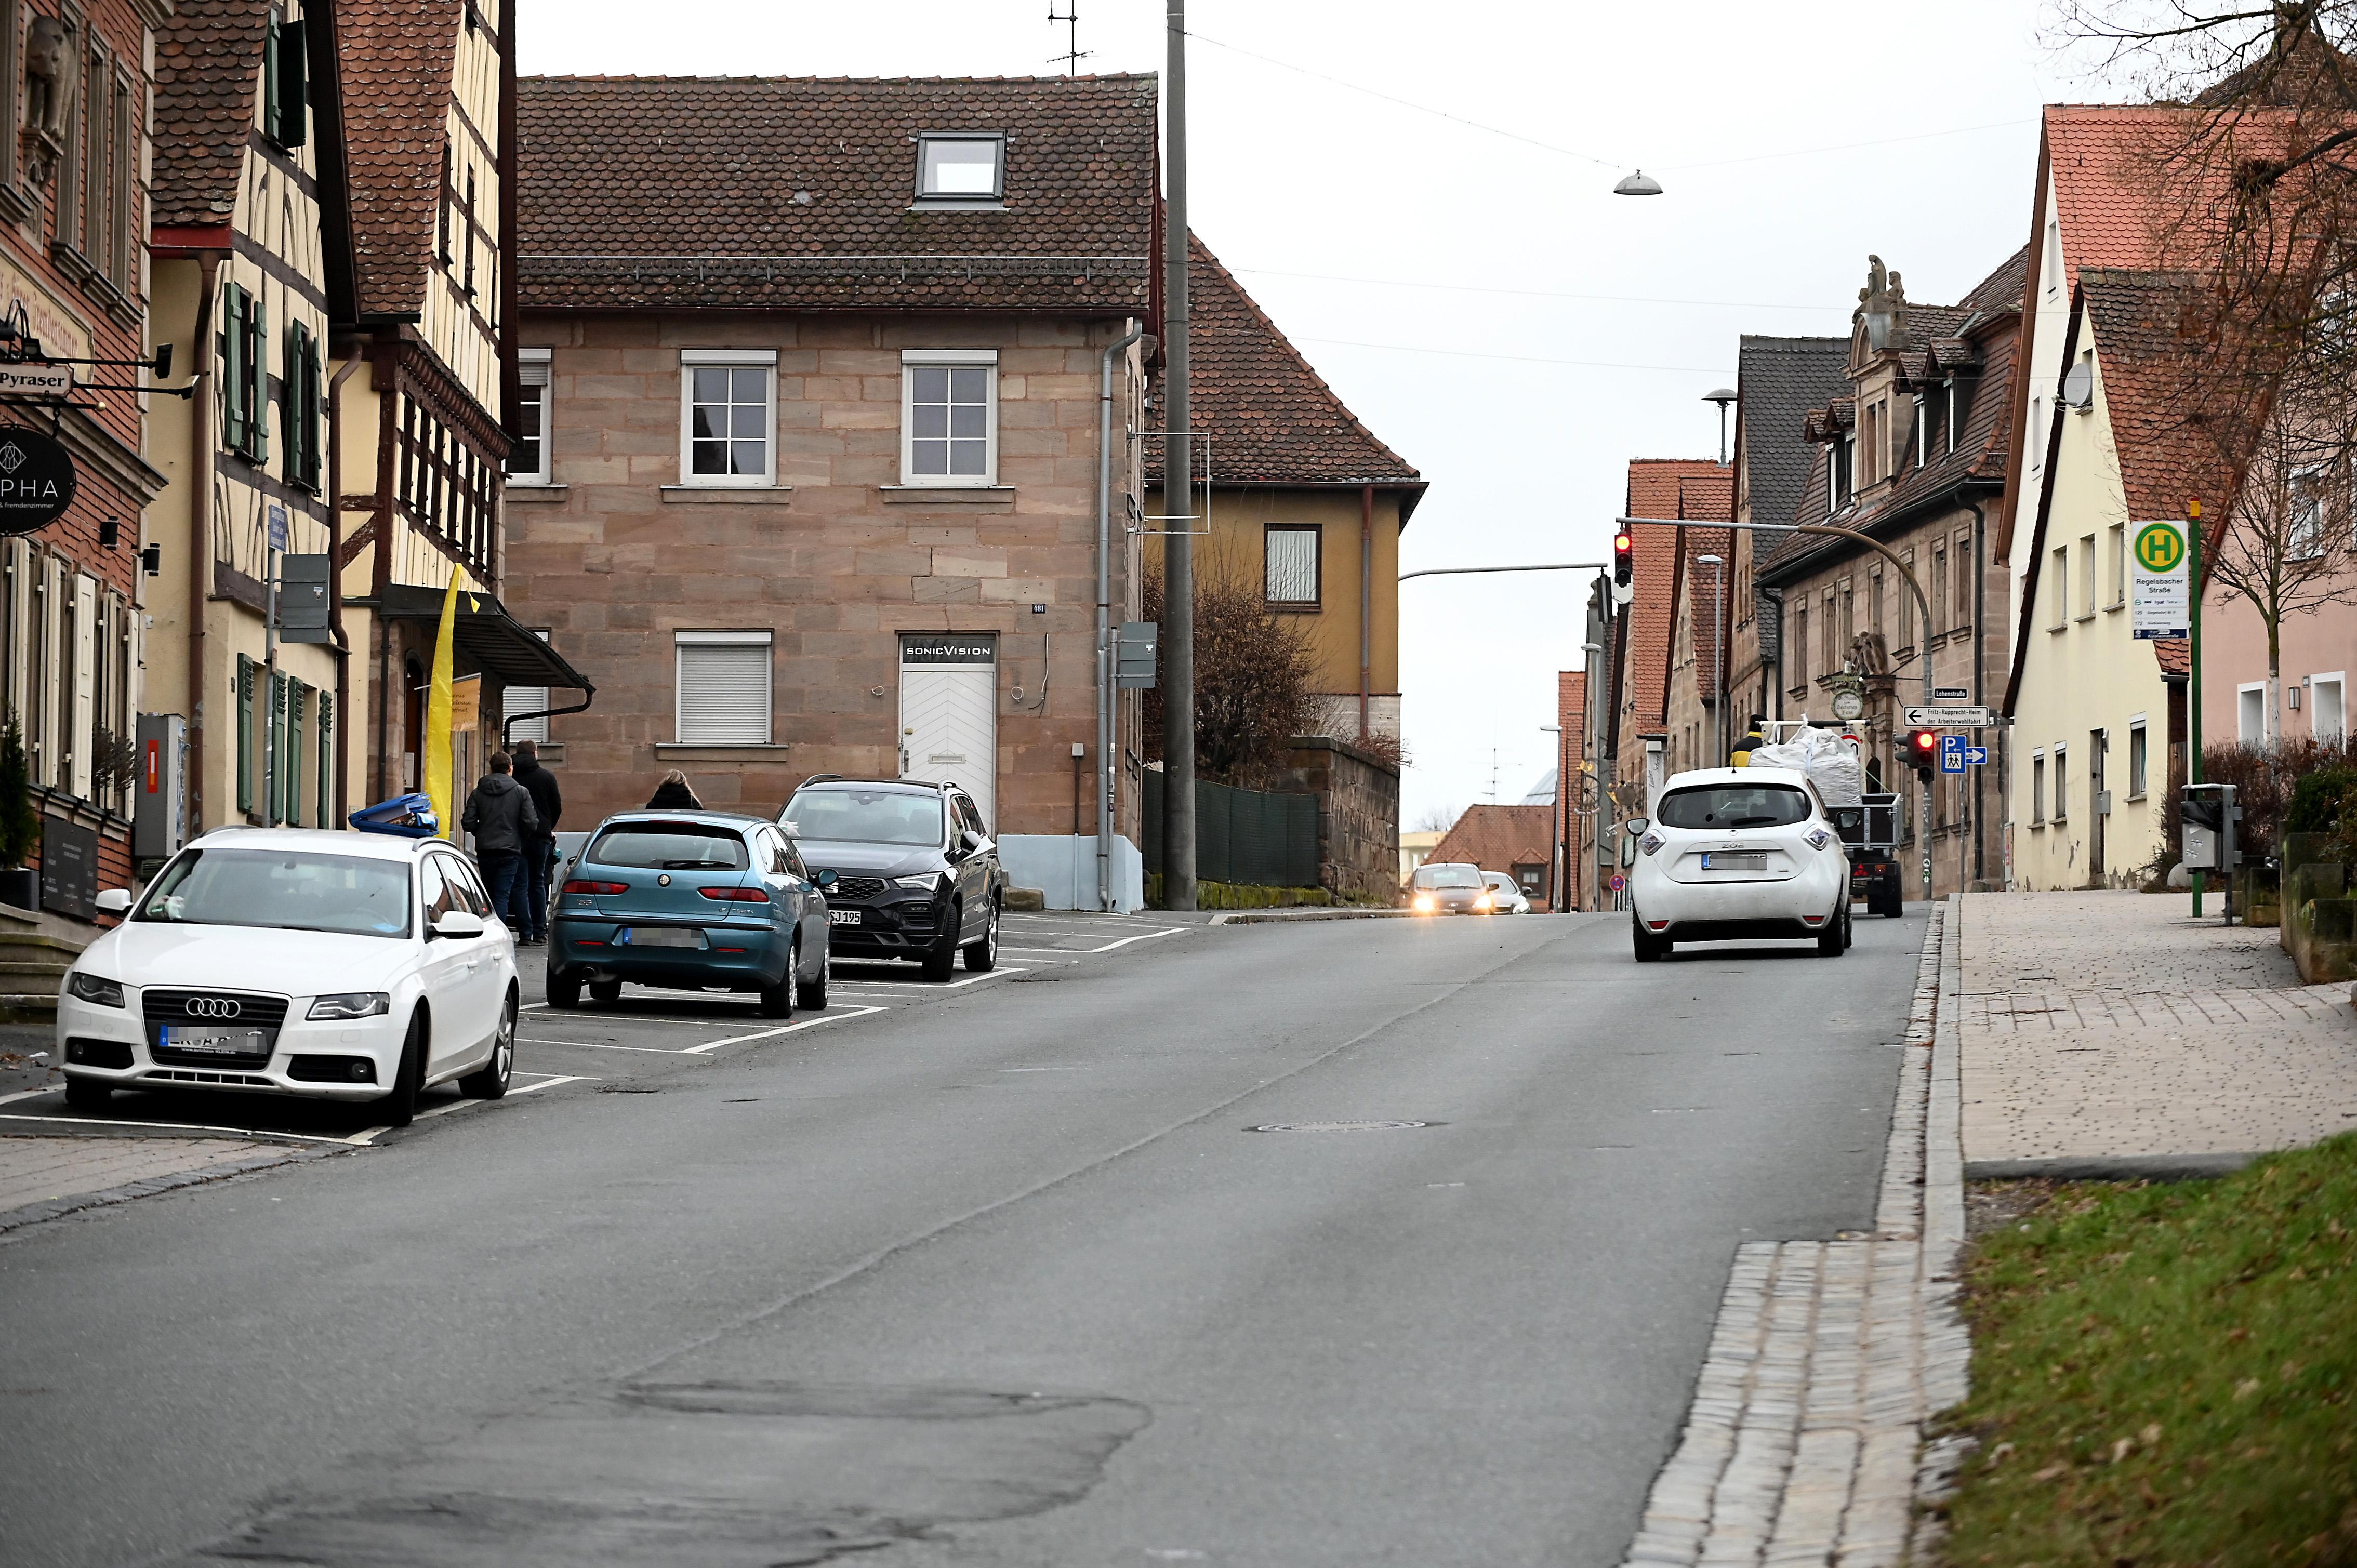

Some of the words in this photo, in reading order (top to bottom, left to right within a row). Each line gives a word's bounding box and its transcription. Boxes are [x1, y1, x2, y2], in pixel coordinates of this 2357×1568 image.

[0, 371, 65, 388] Pyraser
[2149, 535, 2171, 561] H
[1945, 737, 1956, 752] P
[843, 912, 860, 923] 195
